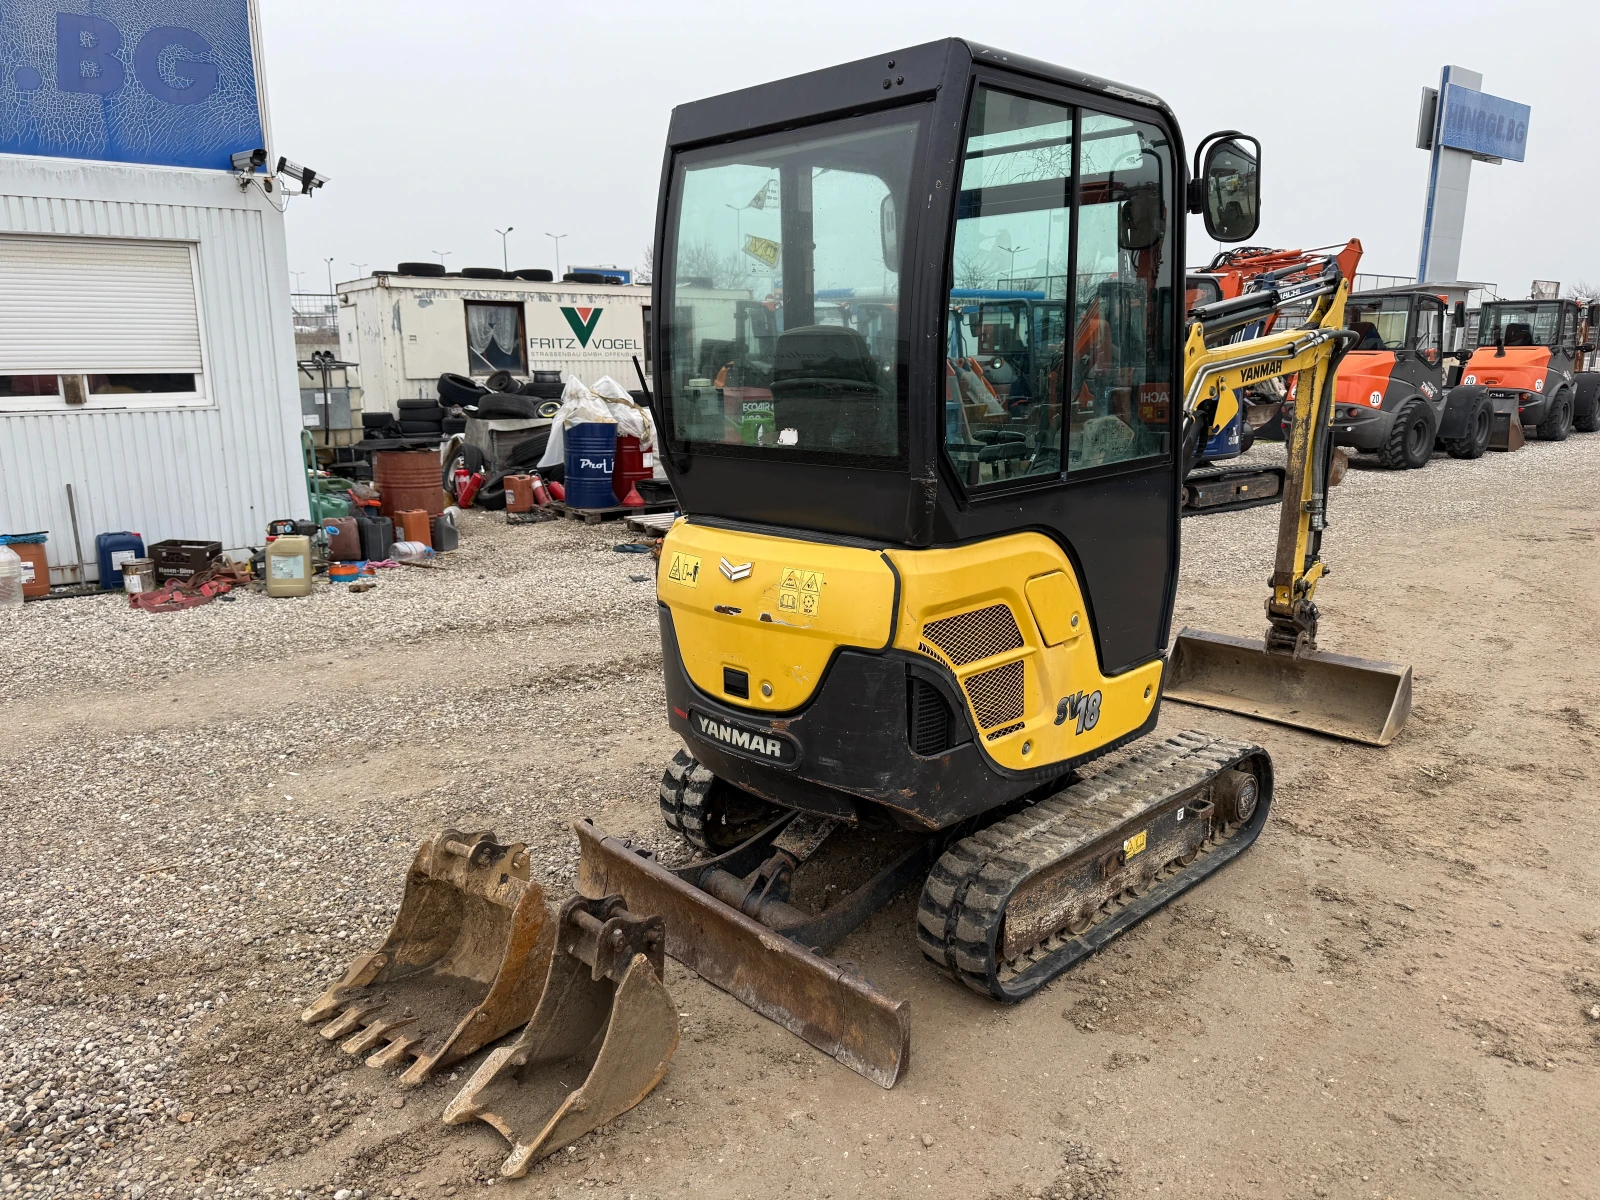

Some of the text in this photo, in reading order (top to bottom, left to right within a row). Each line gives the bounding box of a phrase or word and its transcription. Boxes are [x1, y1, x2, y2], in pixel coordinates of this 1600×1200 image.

[530, 338, 642, 349] FRITZ VOGEL
[1241, 360, 1283, 382] YANMAR
[1466, 377, 1475, 385] 20
[1371, 394, 1380, 404] 20
[742, 402, 770, 412] ECOAIR
[698, 714, 781, 757] YANMAR
